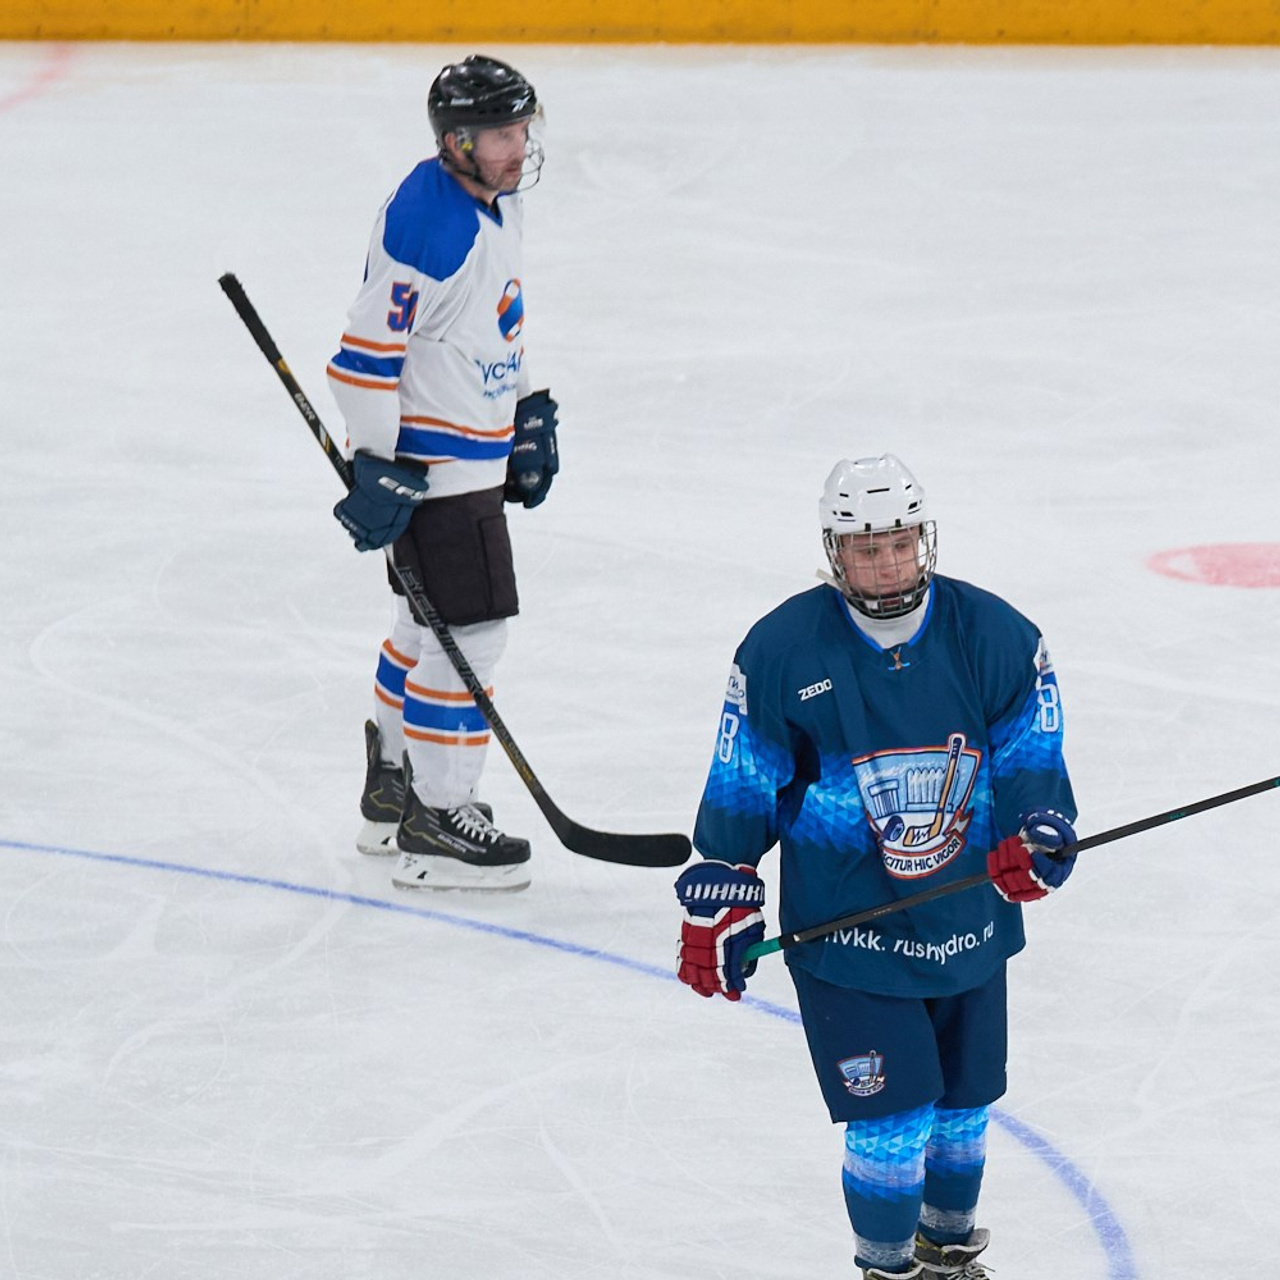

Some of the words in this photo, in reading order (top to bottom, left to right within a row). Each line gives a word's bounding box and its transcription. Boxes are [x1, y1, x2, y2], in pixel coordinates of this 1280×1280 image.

[798, 679, 832, 701] ZEDO
[914, 857, 933, 871] HIC
[933, 838, 961, 865] VIGOR
[893, 933, 980, 965] rushydro.
[983, 920, 994, 942] ru
